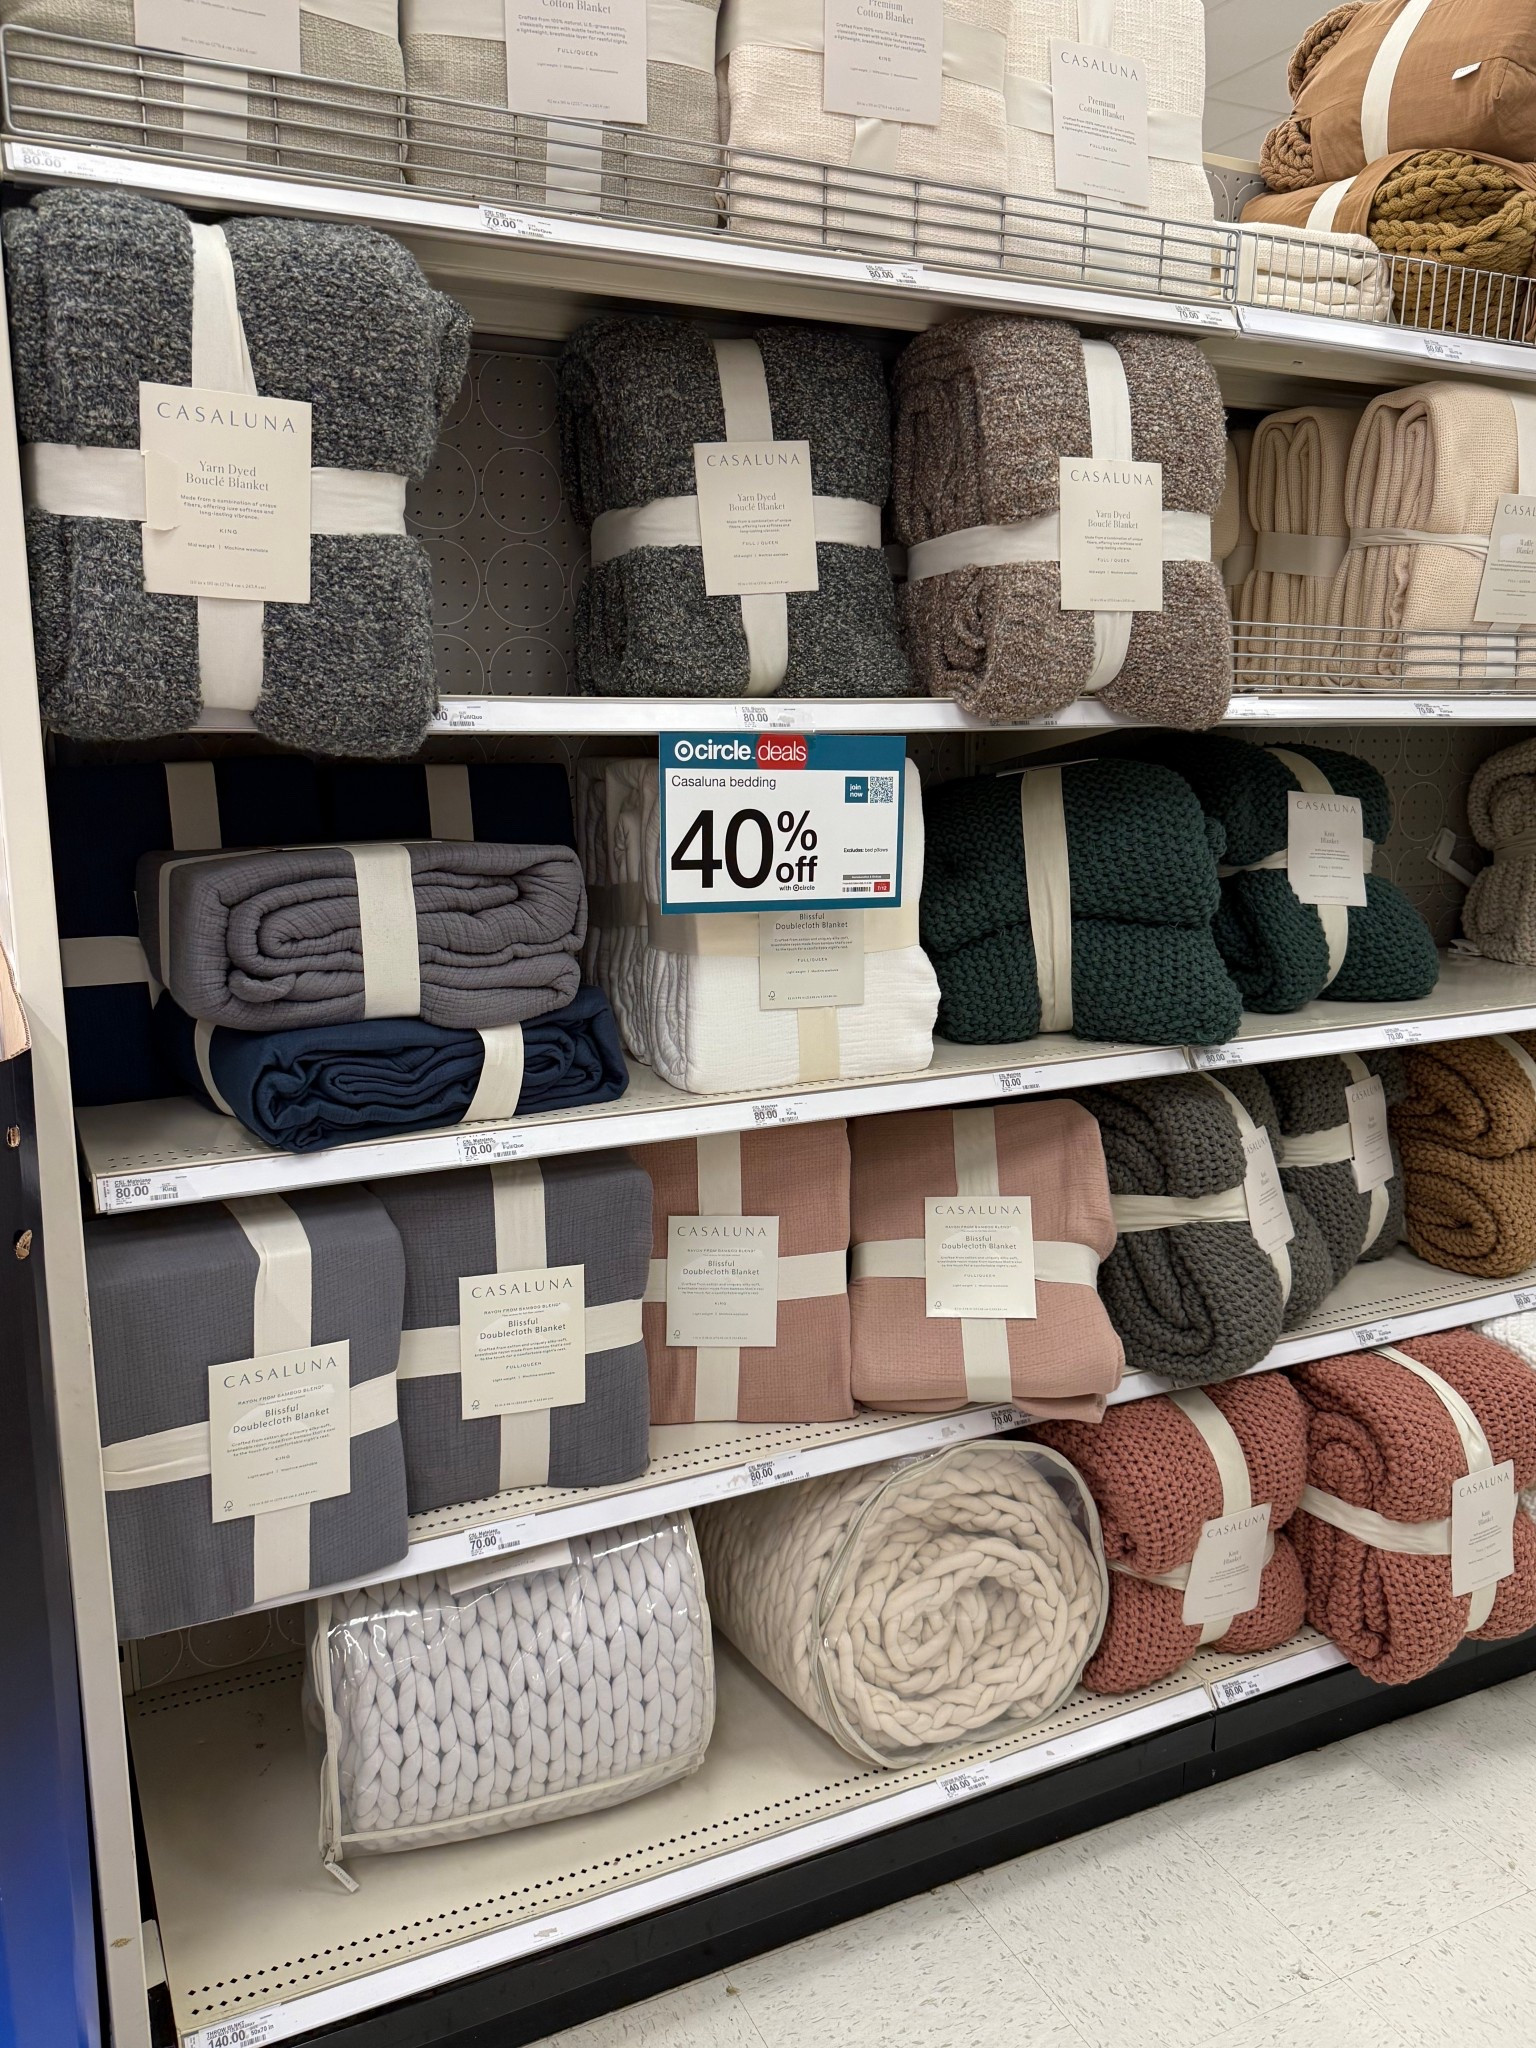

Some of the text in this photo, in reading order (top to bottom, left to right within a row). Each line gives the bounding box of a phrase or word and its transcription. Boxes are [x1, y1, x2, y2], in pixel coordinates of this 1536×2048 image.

[543, 0, 611, 14] Cotton Blanket
[869, 0, 903, 11] Premium
[857, 6, 914, 25] Cotton Blanket
[1061, 52, 1138, 81] CASALUNA
[1088, 96, 1116, 109] Premium
[1079, 104, 1125, 121] Cotton Blanket
[23, 155, 61, 168] 80.00
[487, 217, 516, 228] 70.00
[157, 402, 296, 433] CASALUNA
[707, 453, 800, 467] CASALUNA
[200, 460, 256, 478] Yarn Dyed
[186, 472, 269, 491] Bouclé Blanket
[1070, 470, 1153, 486] CASALUNA
[737, 493, 776, 502] Yarn Dyed
[199, 510, 232, 518] long-lasting
[729, 503, 785, 512] Bouclé Blanket
[1096, 510, 1131, 520] Yarn Dyed
[1088, 519, 1138, 529] Bouclé Blanket
[744, 714, 768, 722] 80.00
[694, 739, 807, 761] circle deals
[671, 775, 776, 790] Casaluna bedding
[1297, 800, 1356, 814] CASALUNA
[776, 856, 818, 883] off
[776, 922, 819, 930] Doublecloth
[1001, 1078, 1021, 1088] 70.00
[754, 1110, 777, 1120] 80.00
[464, 1144, 492, 1155] 70.00
[115, 1186, 149, 1198] 80.00
[935, 1205, 1021, 1215] CASALUNA
[677, 1226, 767, 1237] CASALUNA
[472, 1277, 573, 1299] CASALUNA
[509, 1318, 538, 1327] Blissful
[480, 1324, 566, 1340] Doublecloth Blanket
[223, 1356, 337, 1388] CASALUNA
[266, 1403, 299, 1417] Blissful
[233, 1407, 329, 1433] Doublecloth Blanket
[993, 1414, 1012, 1426] 70.00
[751, 1468, 772, 1480] 80.00
[1460, 1472, 1509, 1498] CASALUNA
[1207, 1513, 1265, 1538] CASALUNA
[470, 1536, 496, 1550] 70.00
[1224, 1685, 1243, 1697] 80.00
[945, 1780, 970, 1793] 140.00
[206, 2027, 226, 2037] THROW
[251, 2026, 268, 2036] 50x70
[209, 2030, 245, 2048] 140.00
